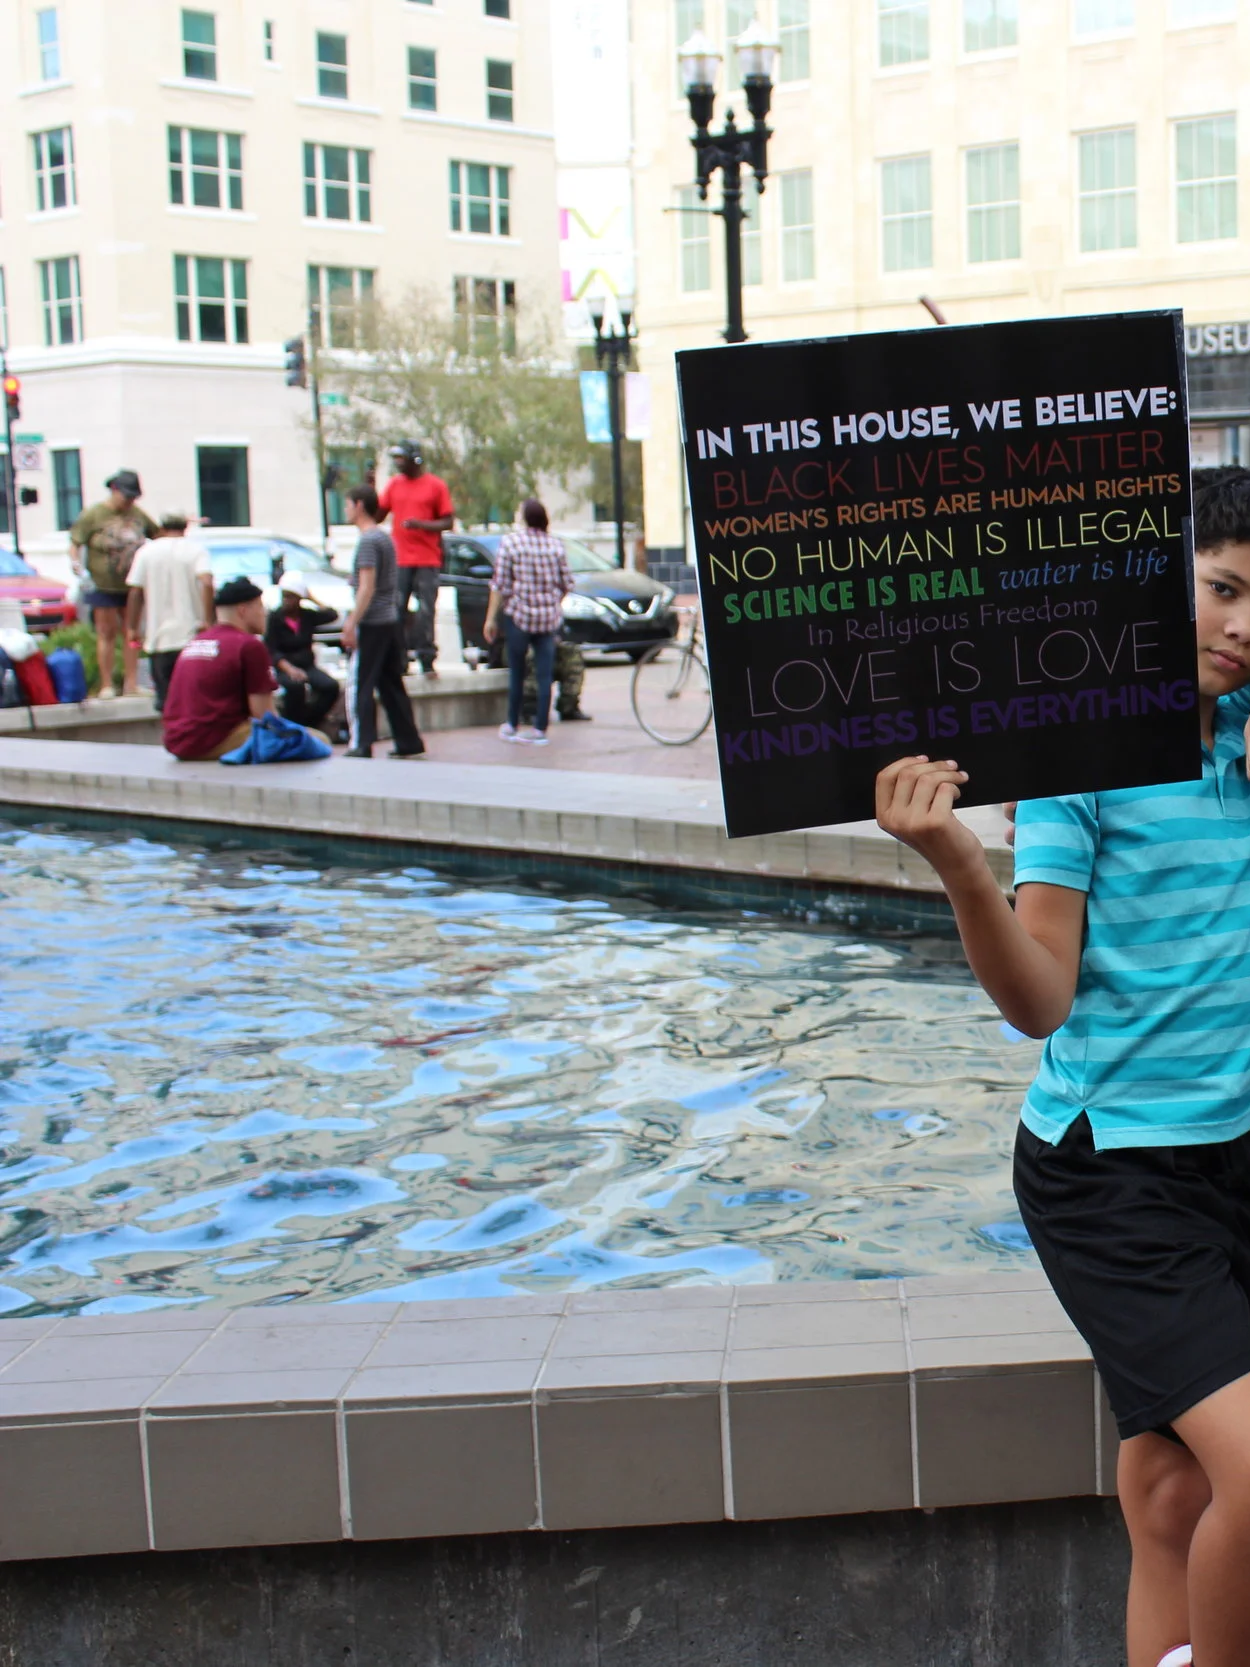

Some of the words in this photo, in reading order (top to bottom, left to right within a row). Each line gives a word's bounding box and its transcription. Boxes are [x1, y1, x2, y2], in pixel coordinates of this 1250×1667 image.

[696, 426, 734, 460] IN
[742, 418, 822, 454] THIS
[832, 404, 960, 446] HOUSE,
[967, 398, 1023, 433] WE
[1035, 386, 1178, 427] BELIEVE:
[704, 507, 829, 540] WOMEN’S
[837, 496, 927, 527] RIGHTS
[933, 491, 982, 517] ARE
[990, 481, 1085, 511] HUMAN
[1095, 473, 1182, 500] RIGHTS
[713, 458, 855, 510] BLACK
[873, 444, 986, 493] LIVES
[1005, 429, 1165, 480] MATTER
[708, 546, 777, 585] NO
[796, 526, 954, 576] HUMAN
[975, 521, 1008, 557] IS
[1027, 505, 1182, 551] ILLEGAL
[723, 580, 855, 624] SCIENCE
[867, 575, 897, 607] IS
[909, 567, 985, 603] REAL
[998, 561, 1081, 590] water
[1091, 553, 1114, 581] is
[1124, 547, 1169, 586] life
[808, 623, 834, 646] In
[846, 611, 969, 644] Religious
[979, 595, 1098, 626] Freedom
[746, 649, 901, 717] LOVE
[933, 640, 981, 694] IS
[1014, 620, 1163, 686] LOVE
[723, 710, 919, 765] KINDNESS
[926, 705, 960, 739] IS
[970, 678, 1196, 735] EVERYTHING
